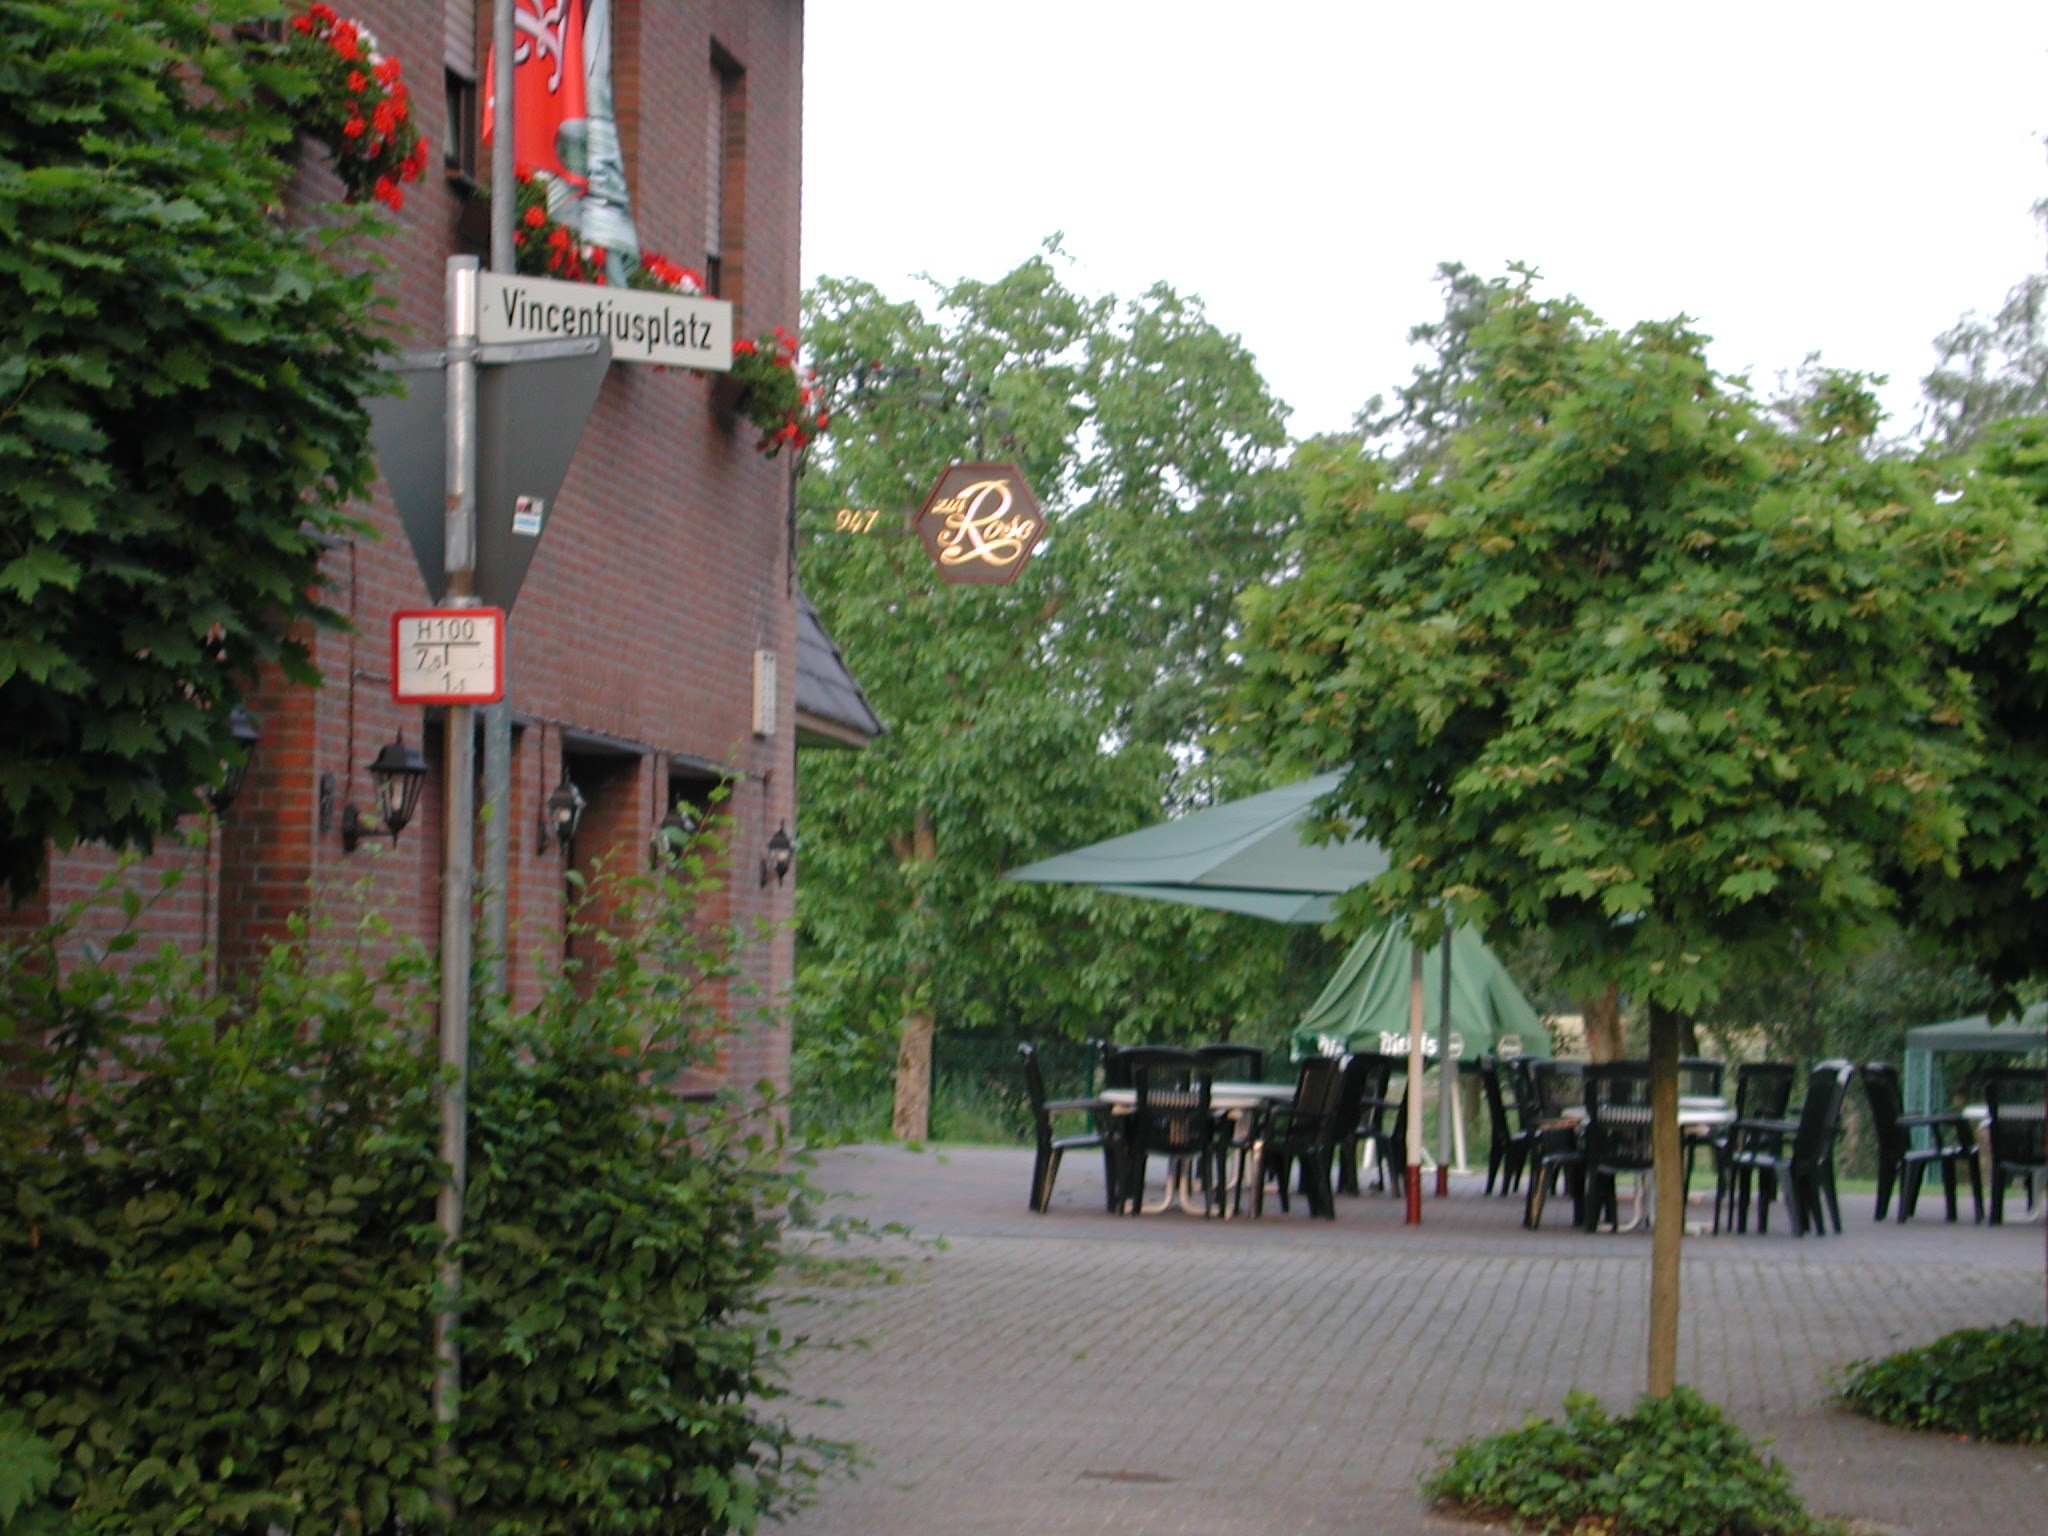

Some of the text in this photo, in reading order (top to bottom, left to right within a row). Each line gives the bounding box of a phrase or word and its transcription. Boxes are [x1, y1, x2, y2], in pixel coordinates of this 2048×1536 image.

[502, 287, 712, 354] Vincentiusplatz
[937, 479, 1036, 566] Rose
[418, 619, 474, 640] H100
